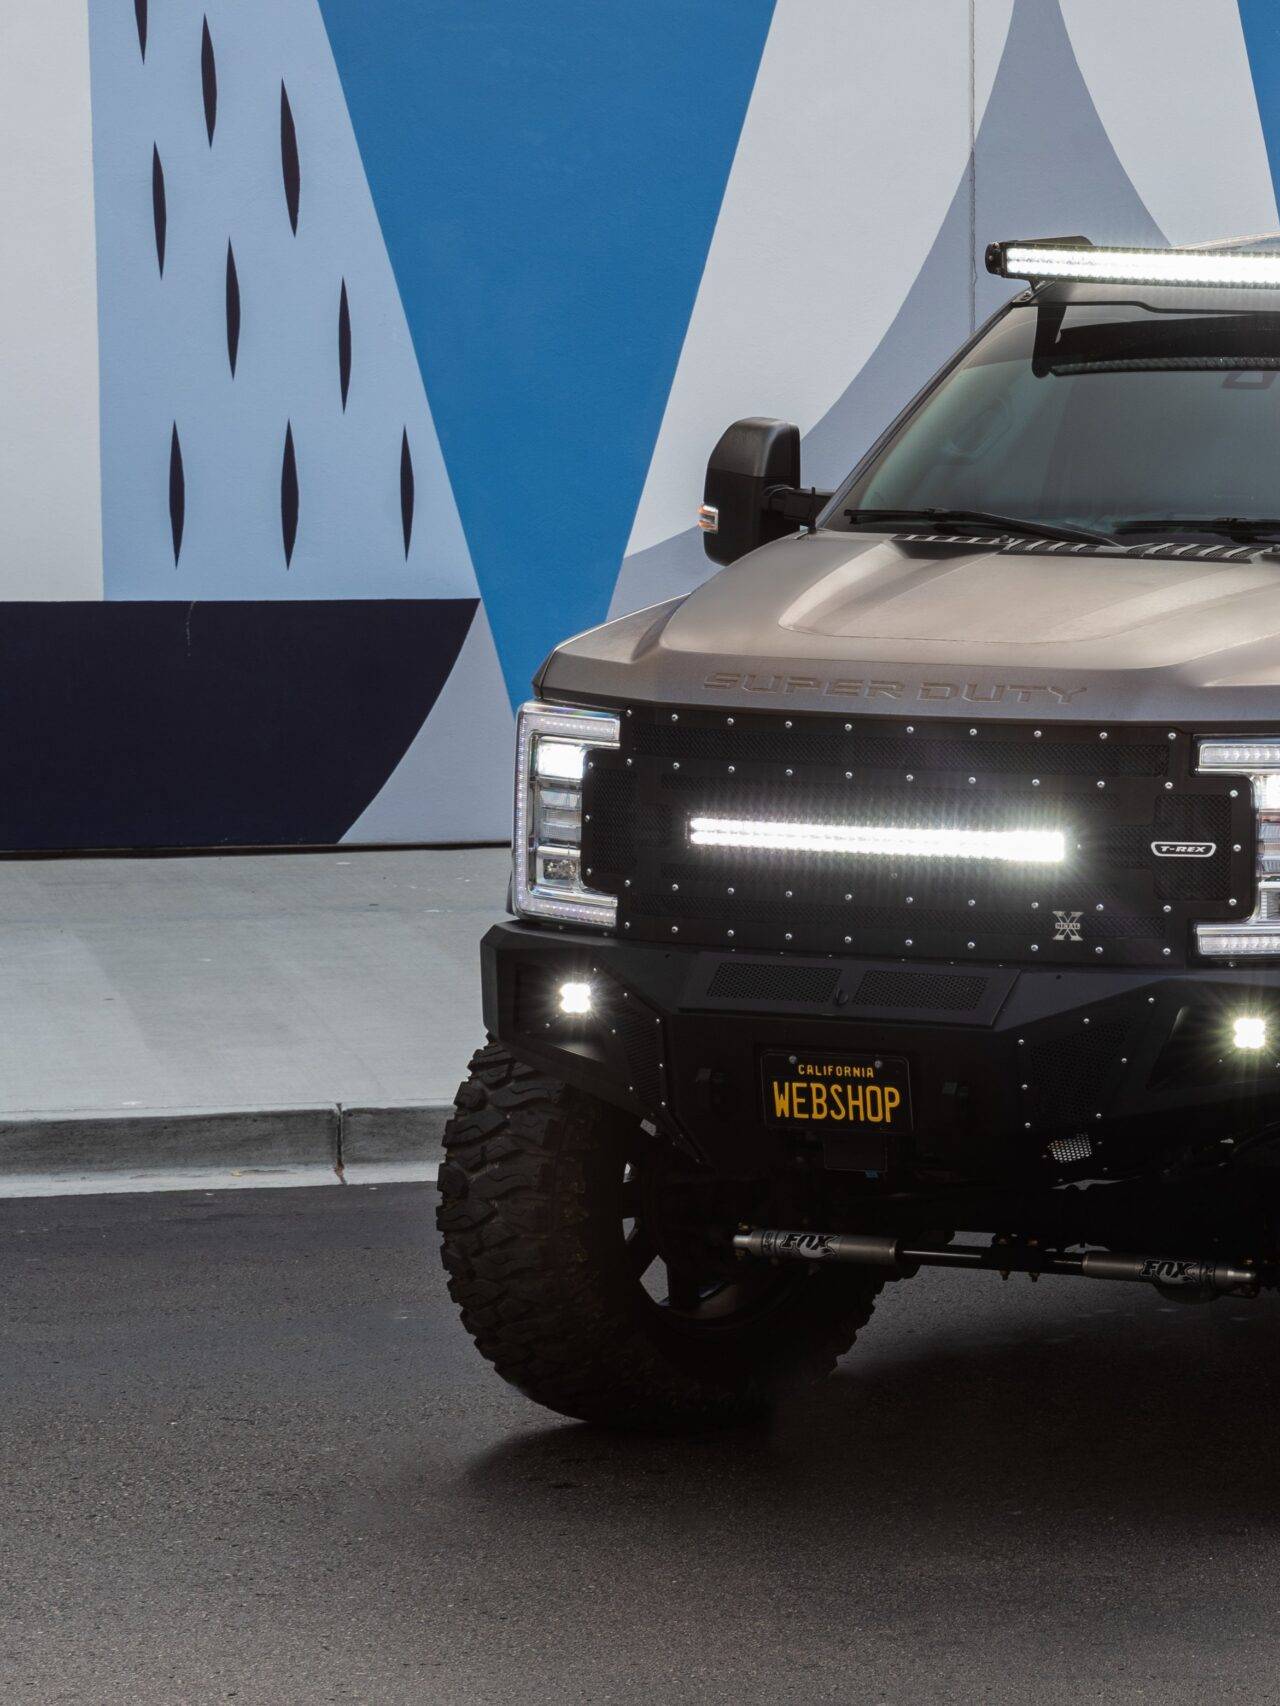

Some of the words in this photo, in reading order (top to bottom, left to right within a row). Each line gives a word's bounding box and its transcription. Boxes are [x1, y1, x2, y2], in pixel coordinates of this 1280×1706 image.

[703, 672, 906, 700] SUPER
[916, 681, 1088, 705] DUTY
[1160, 844, 1207, 854] T-REX
[798, 1064, 875, 1079] CALIFORNIA
[772, 1080, 901, 1124] WEBSHOP
[780, 1232, 836, 1253] FOX
[1141, 1259, 1195, 1280] FOX
